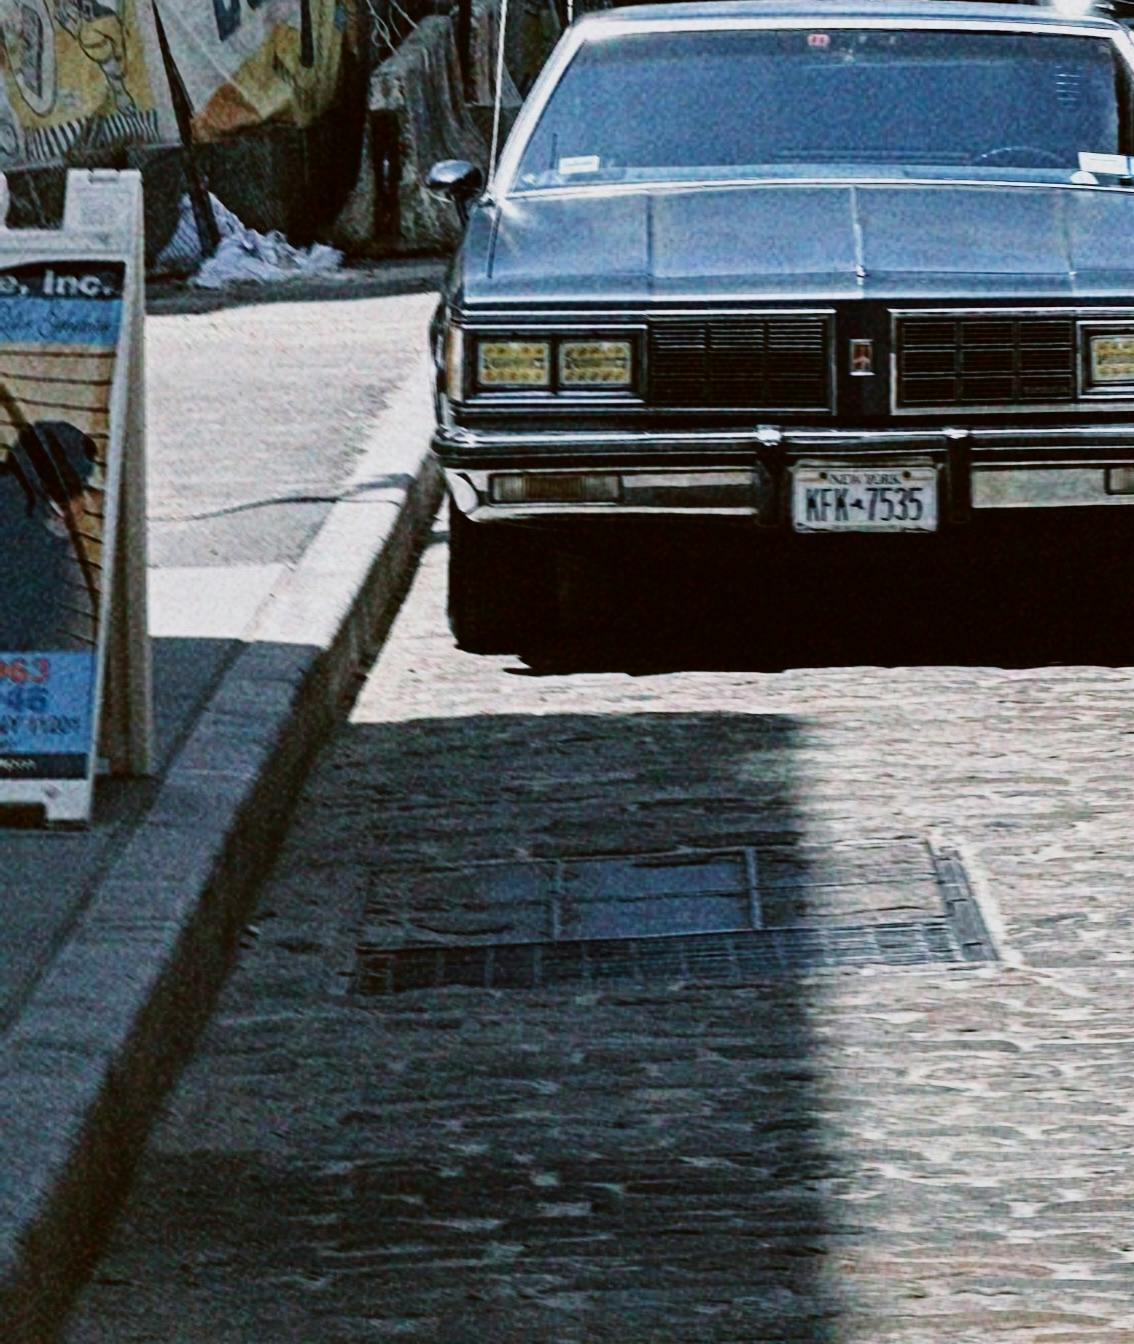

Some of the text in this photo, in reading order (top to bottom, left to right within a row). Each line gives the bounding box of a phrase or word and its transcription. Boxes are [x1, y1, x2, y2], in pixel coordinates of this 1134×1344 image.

[43, 269, 113, 297] Inc.
[830, 473, 903, 486] NEW YORK
